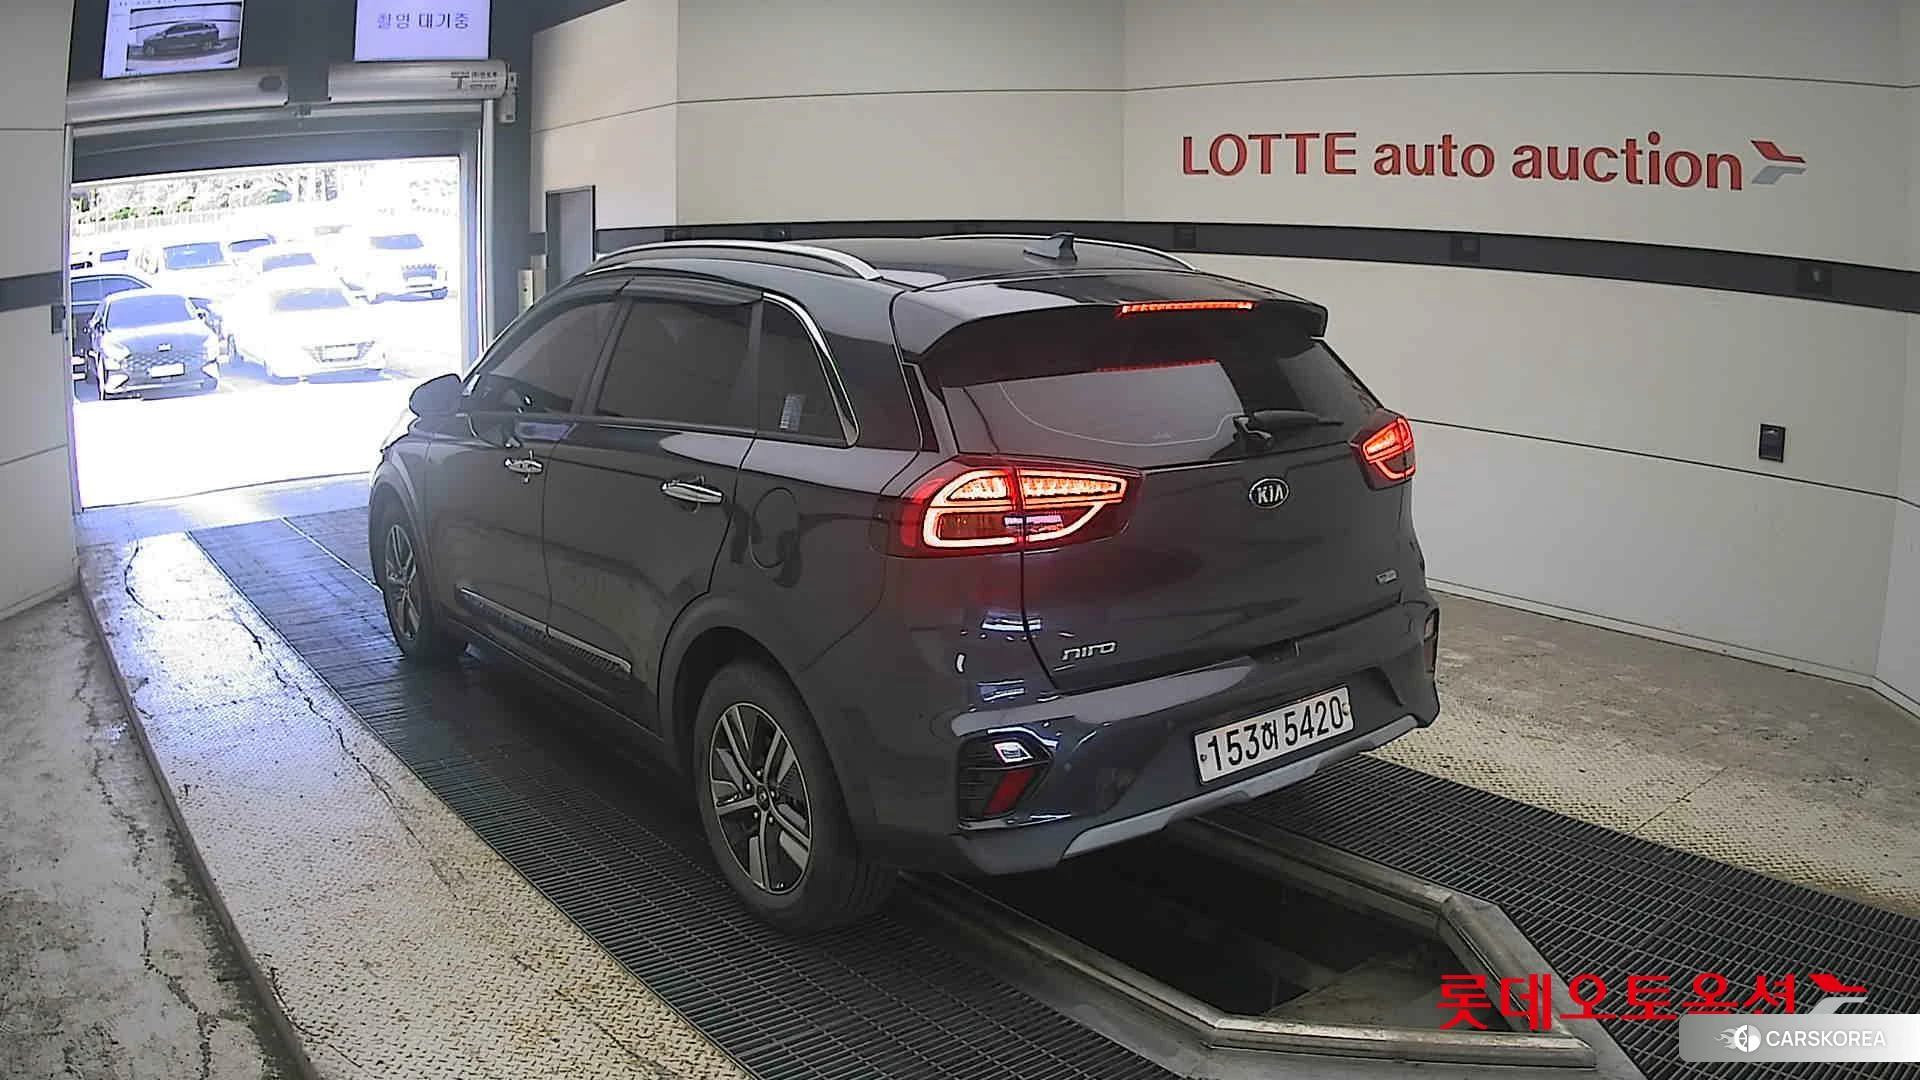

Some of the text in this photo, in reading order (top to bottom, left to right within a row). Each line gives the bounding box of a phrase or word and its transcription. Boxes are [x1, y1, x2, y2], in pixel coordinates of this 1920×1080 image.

[1182, 131, 1743, 191] LOTTE auto auction
[1256, 484, 1284, 504] KIA
[1284, 696, 1344, 746] 5420
